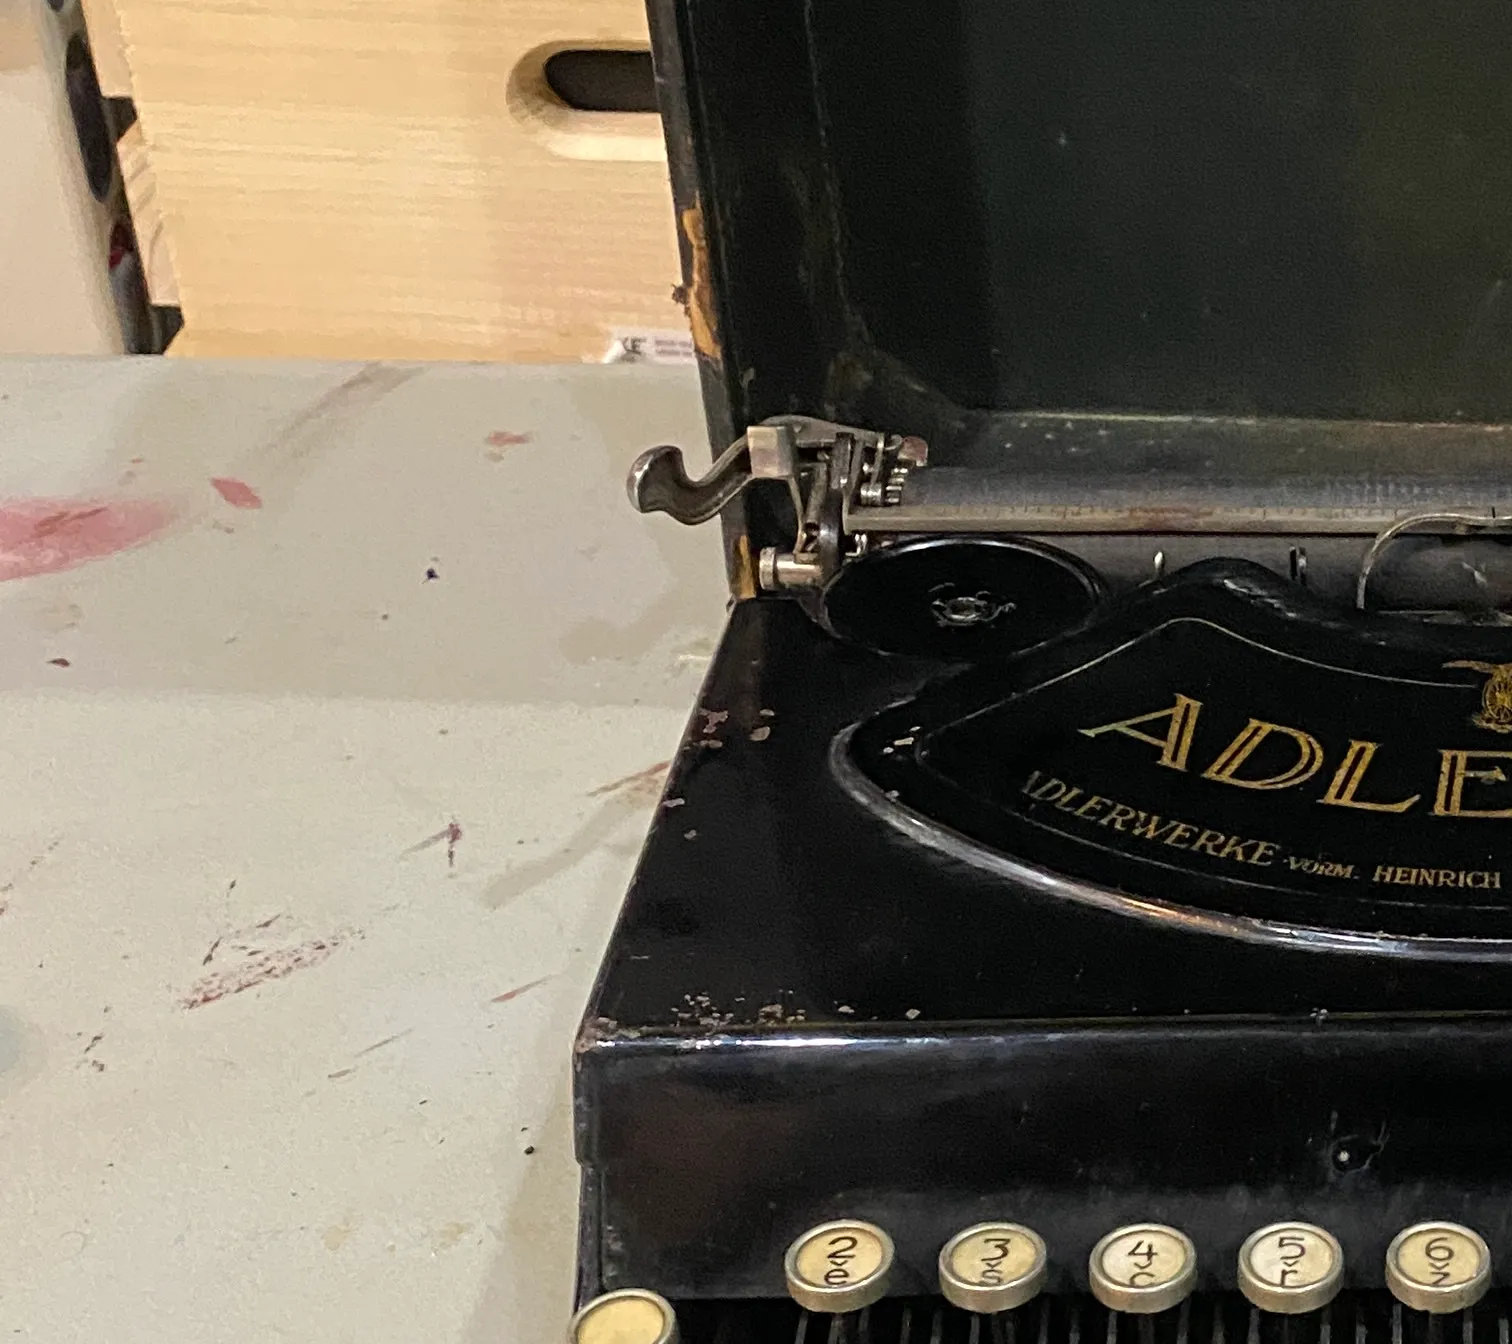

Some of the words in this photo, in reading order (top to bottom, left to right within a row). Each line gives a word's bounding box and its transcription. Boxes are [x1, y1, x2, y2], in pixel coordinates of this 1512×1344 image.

[1372, 864, 1501, 889] HEINRICH
[827, 1236, 858, 1258] 2
[981, 1238, 1011, 1262] 3
[1127, 1239, 1158, 1261] 4
[1278, 1236, 1306, 1260] 5
[1424, 1237, 1455, 1262] 6
